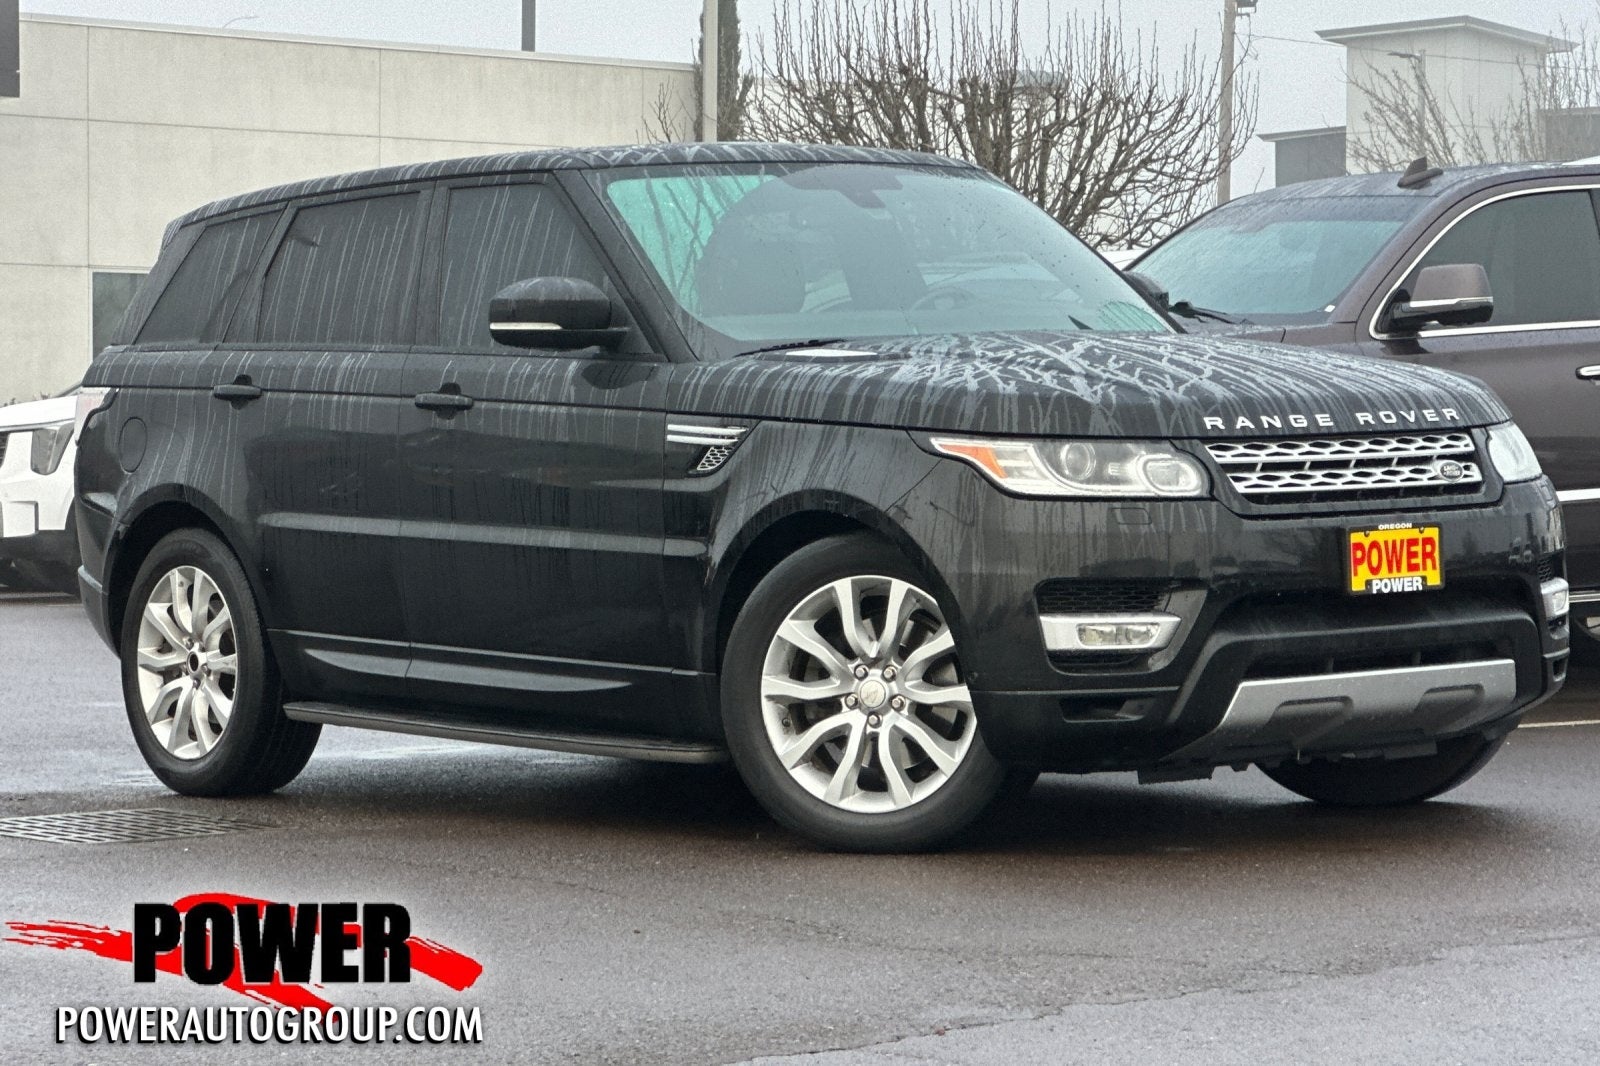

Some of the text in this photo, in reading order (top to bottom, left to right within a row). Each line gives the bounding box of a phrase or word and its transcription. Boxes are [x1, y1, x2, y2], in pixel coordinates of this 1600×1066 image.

[1203, 408, 1460, 430] RANGE ROVER
[1351, 536, 1437, 577] POWER
[1371, 576, 1423, 594] POWER
